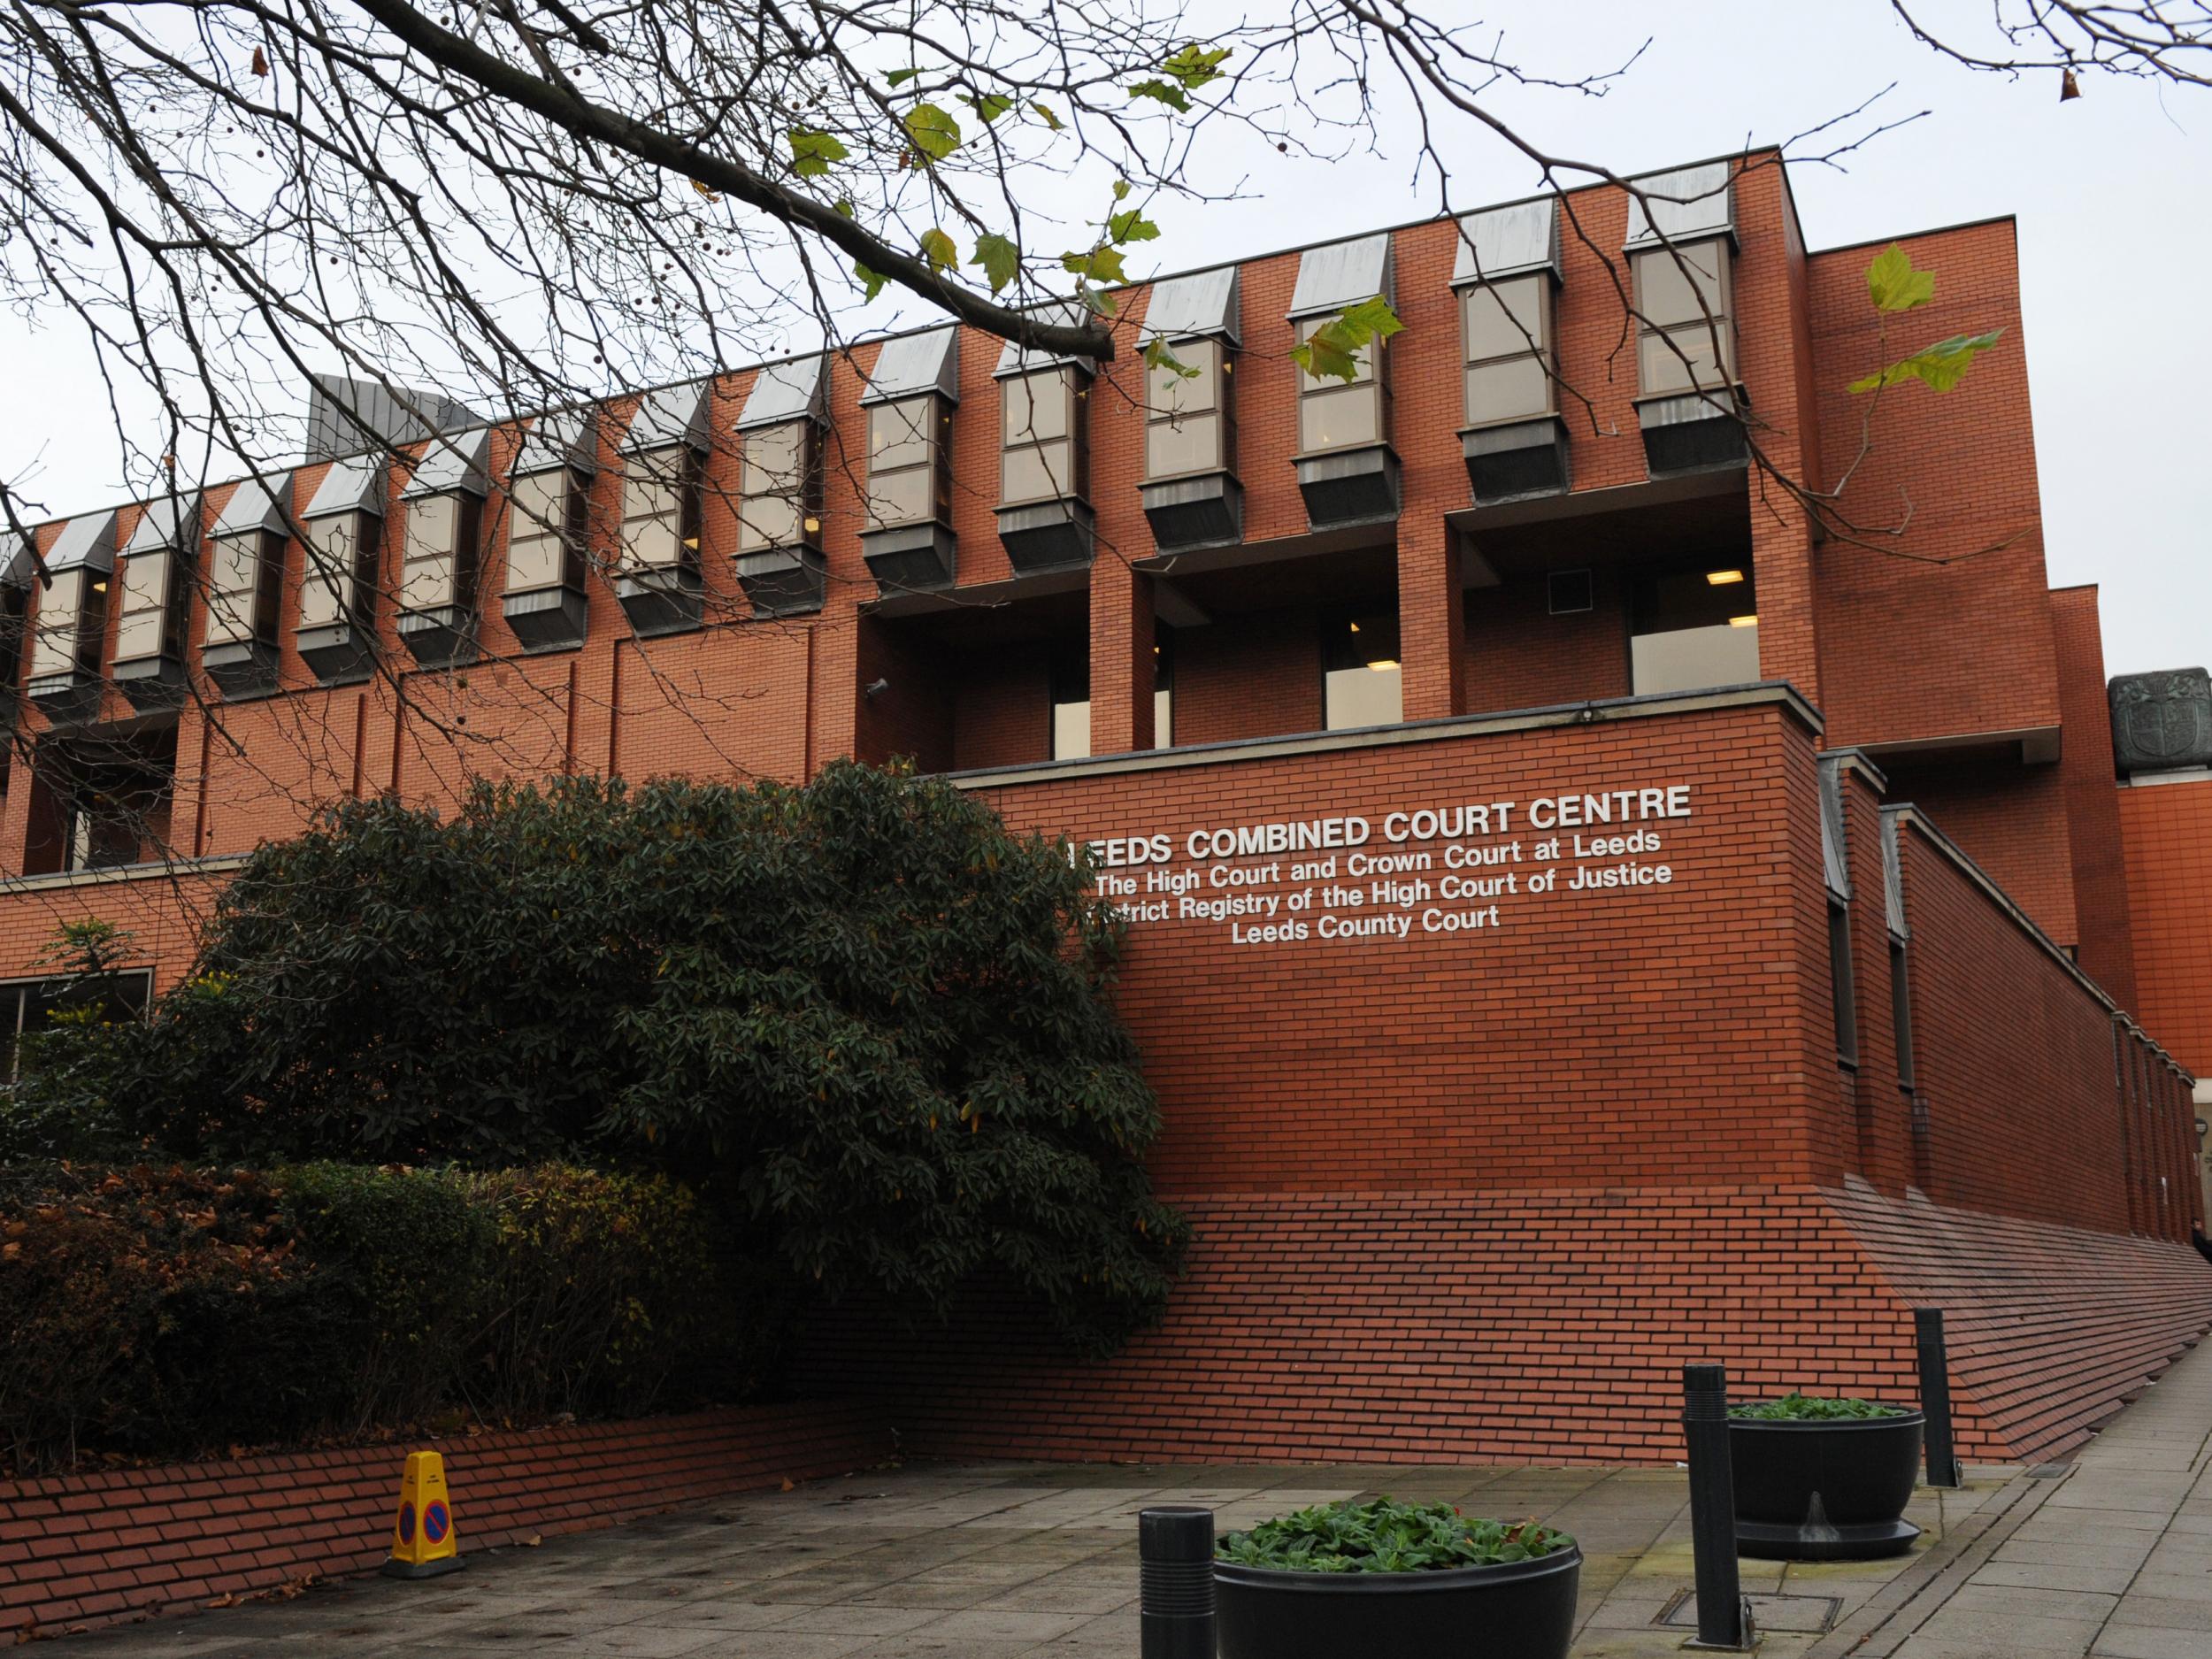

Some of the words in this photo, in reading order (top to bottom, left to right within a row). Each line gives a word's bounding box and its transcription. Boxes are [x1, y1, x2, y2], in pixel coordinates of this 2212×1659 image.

[1187, 817, 1370, 859] COMBINED
[1385, 802, 1516, 842] COURT
[1530, 786, 1692, 829] CENTRE
[1087, 900, 1169, 925] trict
[1179, 895, 1279, 922] Registry
[1288, 888, 1313, 911] of
[1323, 886, 1363, 908] the
[1371, 879, 1431, 908] High
[1440, 872, 1517, 899] Court
[1528, 869, 1555, 893] of
[1569, 862, 1672, 890] Justice
[1095, 875, 1137, 896] The
[1147, 869, 1200, 895] High
[1210, 863, 1280, 887] Court
[1291, 856, 1336, 880] and
[1348, 852, 1432, 877] Crown
[1444, 841, 1522, 869] Court
[1534, 838, 1560, 861] at
[1573, 829, 1661, 857] Leeds
[1232, 919, 1309, 944] Leeds
[1317, 912, 1412, 938] County
[1422, 905, 1500, 933] Court
